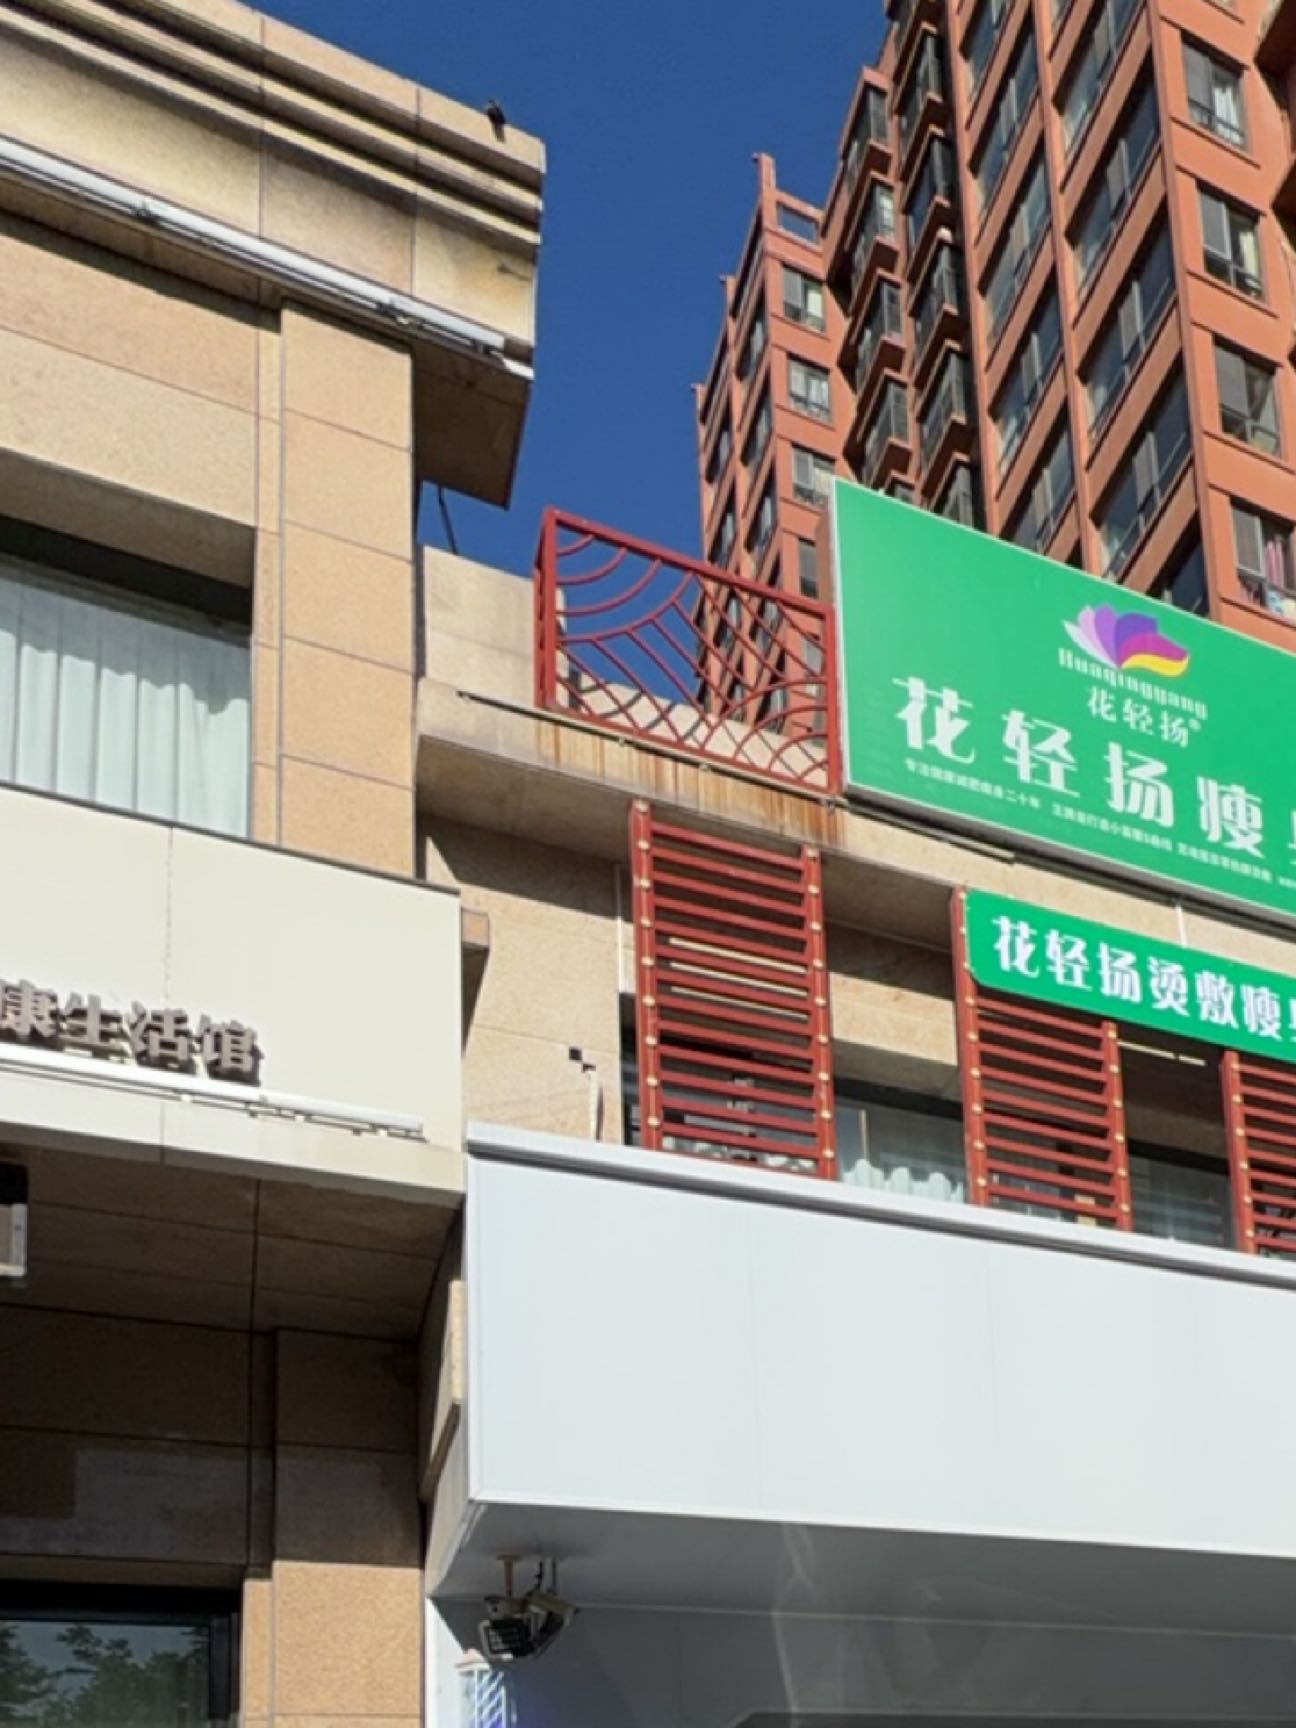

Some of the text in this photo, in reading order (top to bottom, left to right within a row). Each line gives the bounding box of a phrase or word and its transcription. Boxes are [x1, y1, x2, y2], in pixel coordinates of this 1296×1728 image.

[1087, 686, 1190, 748] 花轻扬
[0, 979, 262, 1083] 康生活馆
